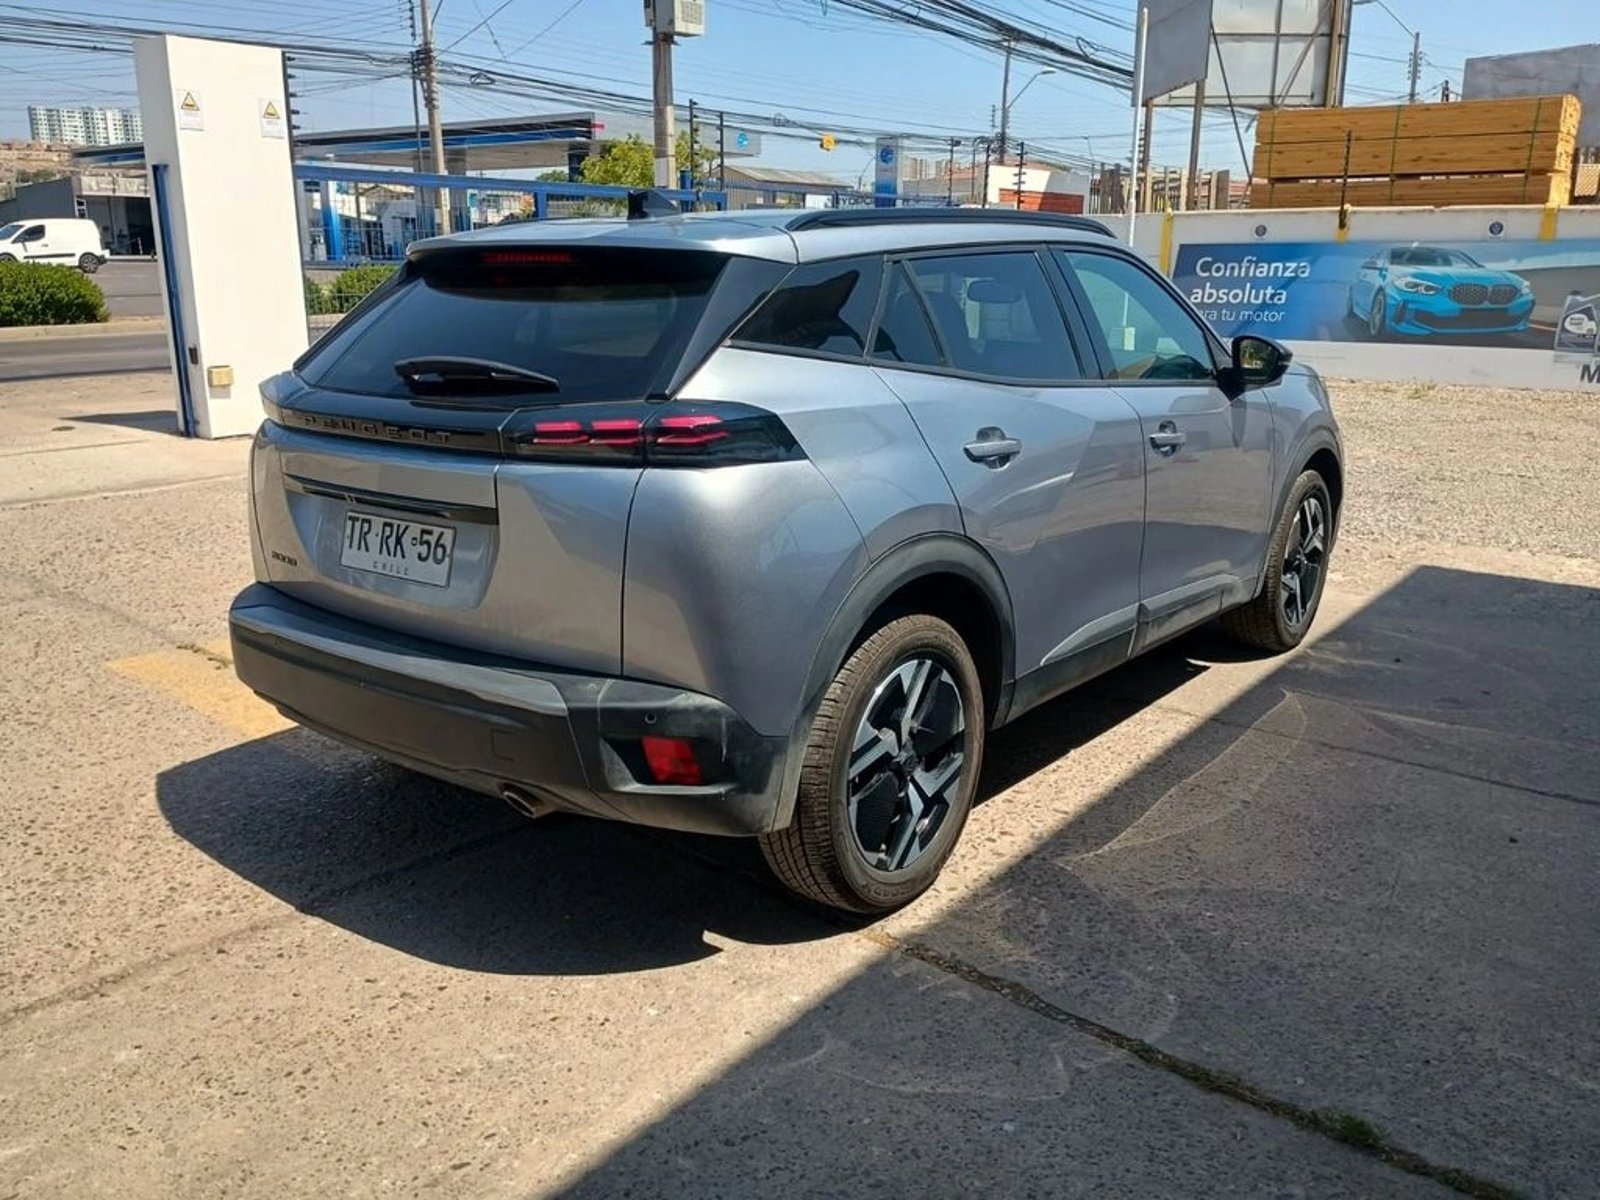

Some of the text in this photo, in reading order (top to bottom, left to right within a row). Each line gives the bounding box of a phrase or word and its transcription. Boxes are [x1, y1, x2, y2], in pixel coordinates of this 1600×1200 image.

[1195, 256, 1311, 278] Confianza
[1190, 282, 1287, 304] absoluta
[1199, 308, 1286, 323] ara tu motor
[303, 415, 451, 445] PEUGEOT
[373, 561, 409, 576] CHILE
